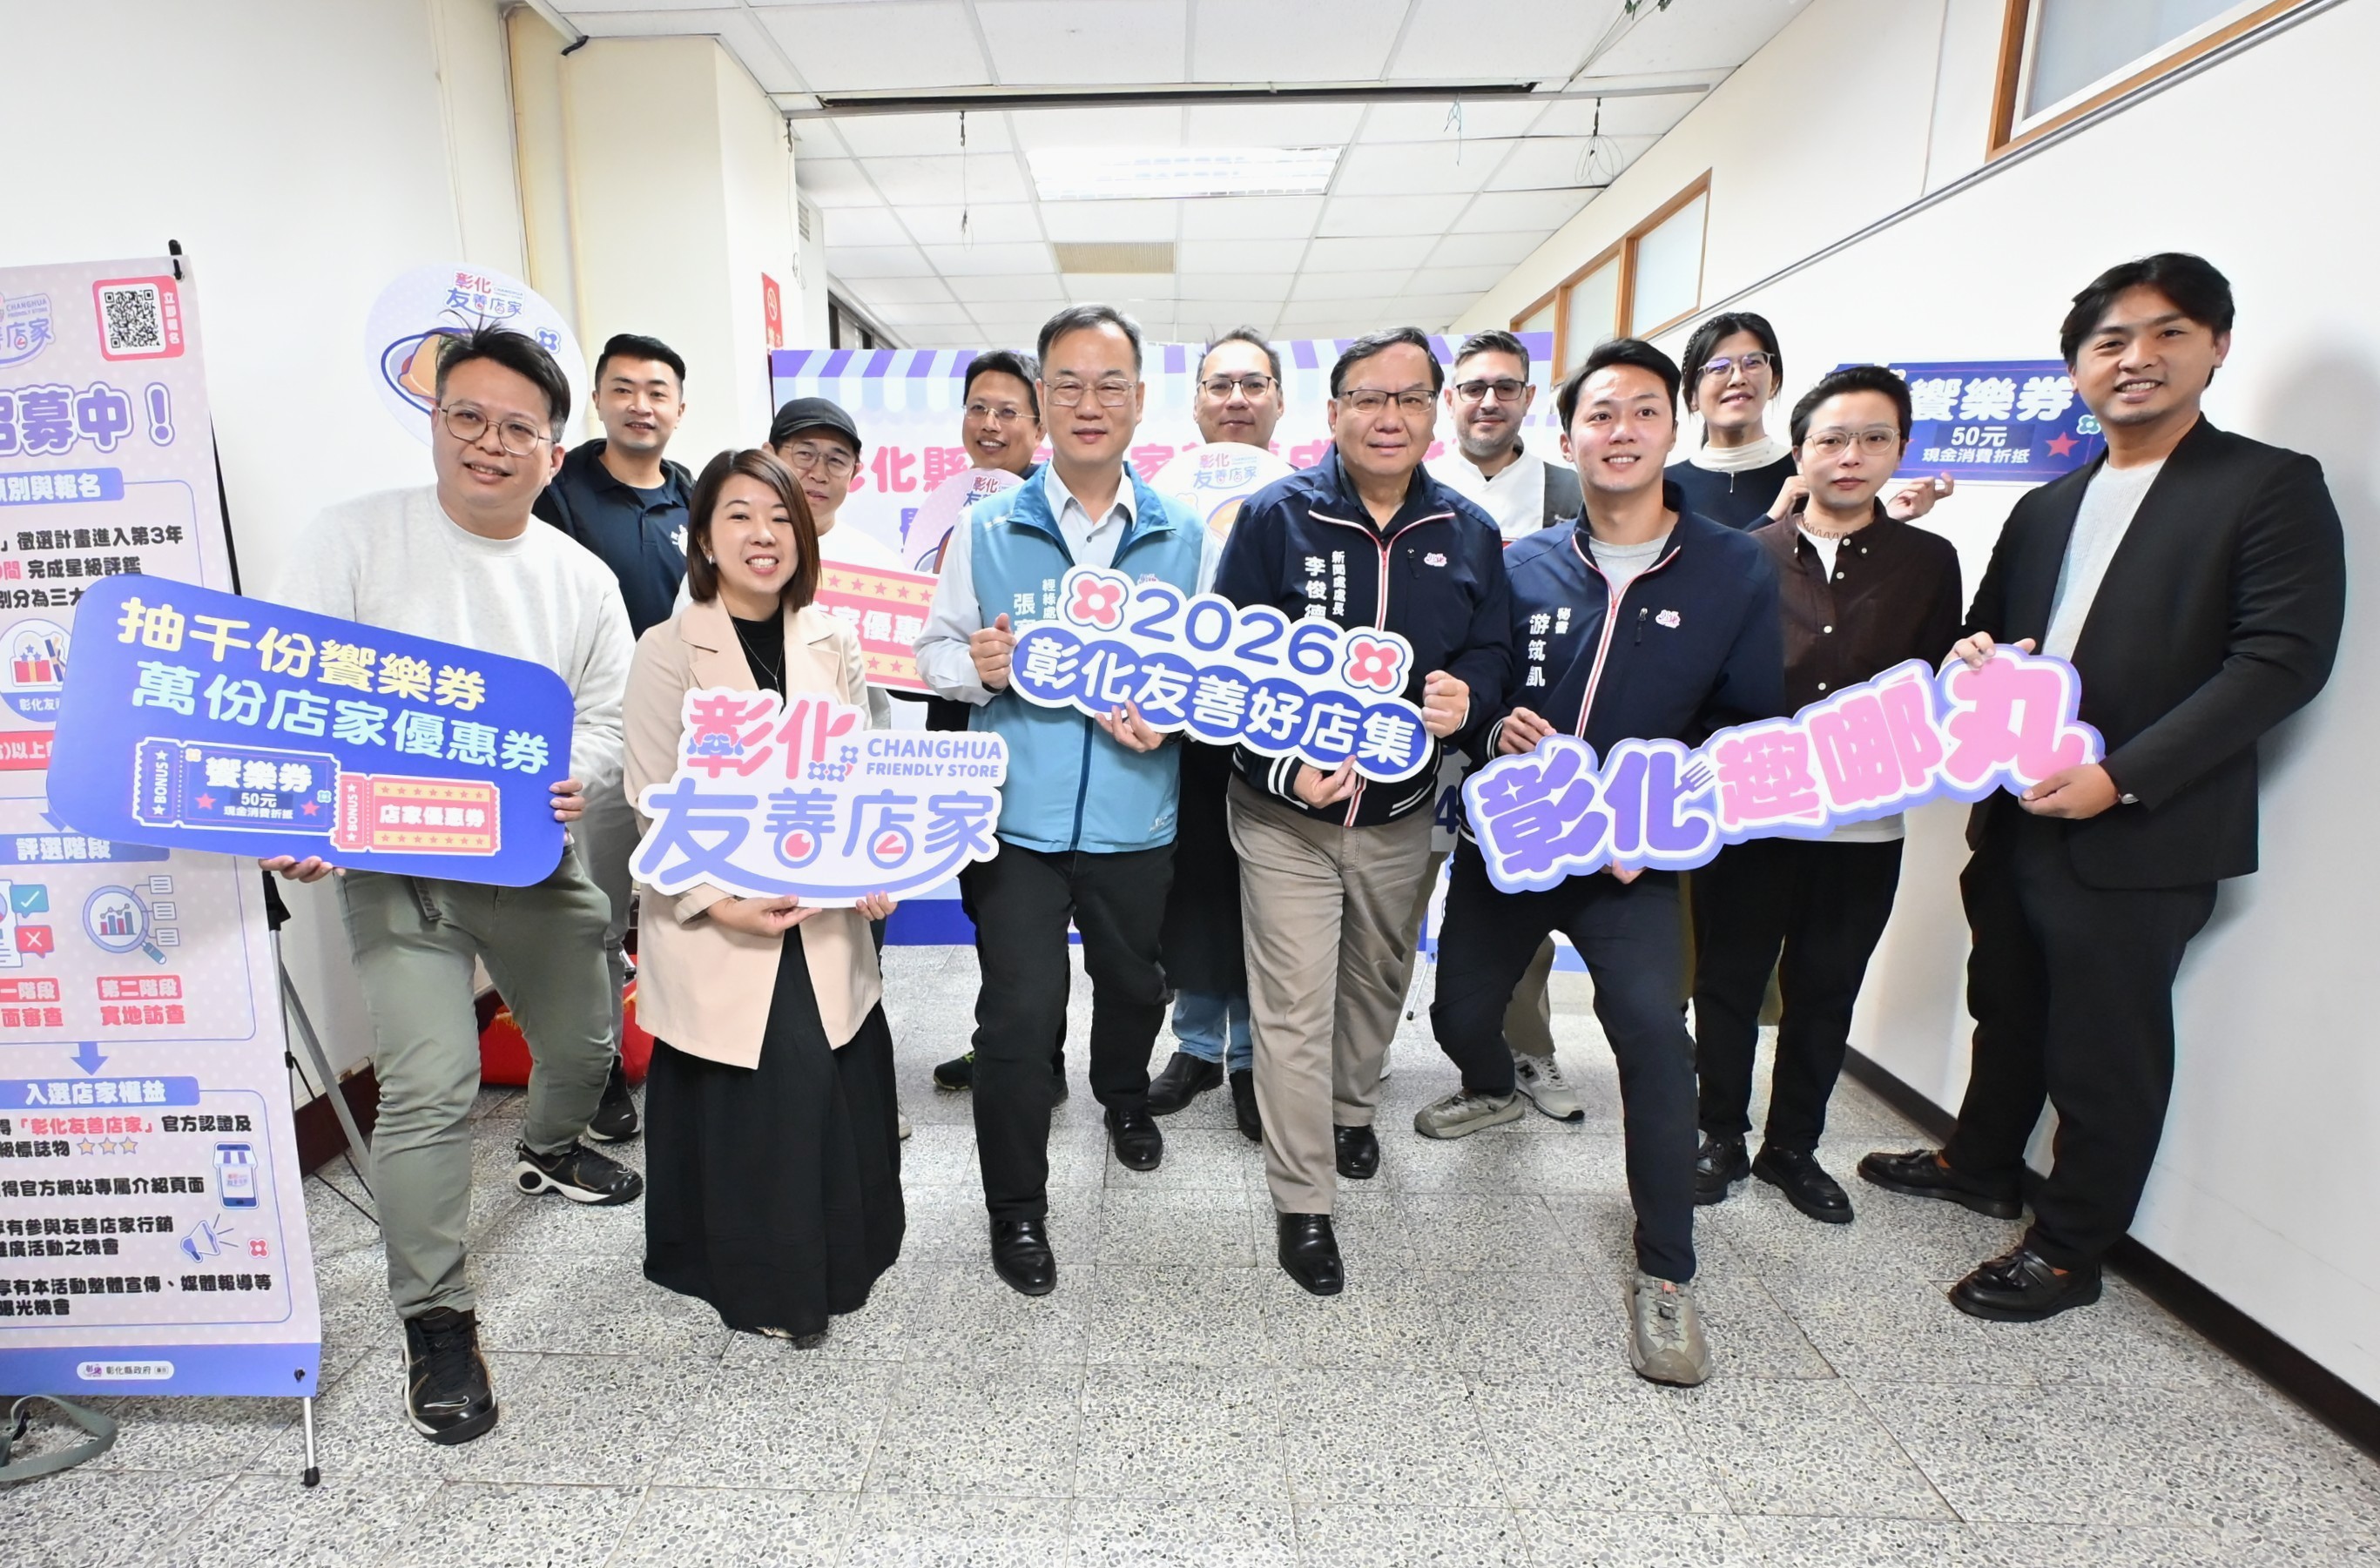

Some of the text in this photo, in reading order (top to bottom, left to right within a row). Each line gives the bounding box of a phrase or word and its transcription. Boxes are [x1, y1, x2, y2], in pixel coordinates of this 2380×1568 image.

[455, 272, 492, 294] 彰化
[446, 287, 523, 319] 友善店家
[0, 318, 51, 352] 店家
[1951, 426, 2007, 448] 50元
[1200, 453, 1230, 469] 彰化
[1921, 448, 2030, 464] 現金消費折抵
[973, 476, 998, 494] 彰化
[1131, 589, 1338, 676] 2026
[118, 596, 486, 712] 抽千份饗樂券
[1021, 636, 1417, 767] 彰化友善好店集
[131, 661, 550, 775] 萬份店家優惠券
[686, 694, 856, 783] 彰化
[867, 737, 1002, 760] CHANGHUA
[866, 762, 1000, 777] FRIENDLY STORE
[154, 762, 169, 804] BONUS
[240, 791, 278, 808] 50元
[223, 805, 293, 820] 現金消費折抵
[347, 793, 358, 831] BONUS
[380, 804, 485, 827] 店家優惠券
[638, 777, 994, 898] 友善店家
[25, 1080, 166, 1107] 入選店家權益
[0, 1176, 205, 1198] 得官方網站專屬介紹頁面
[0, 1216, 173, 1237] 有參與友善店家行銷
